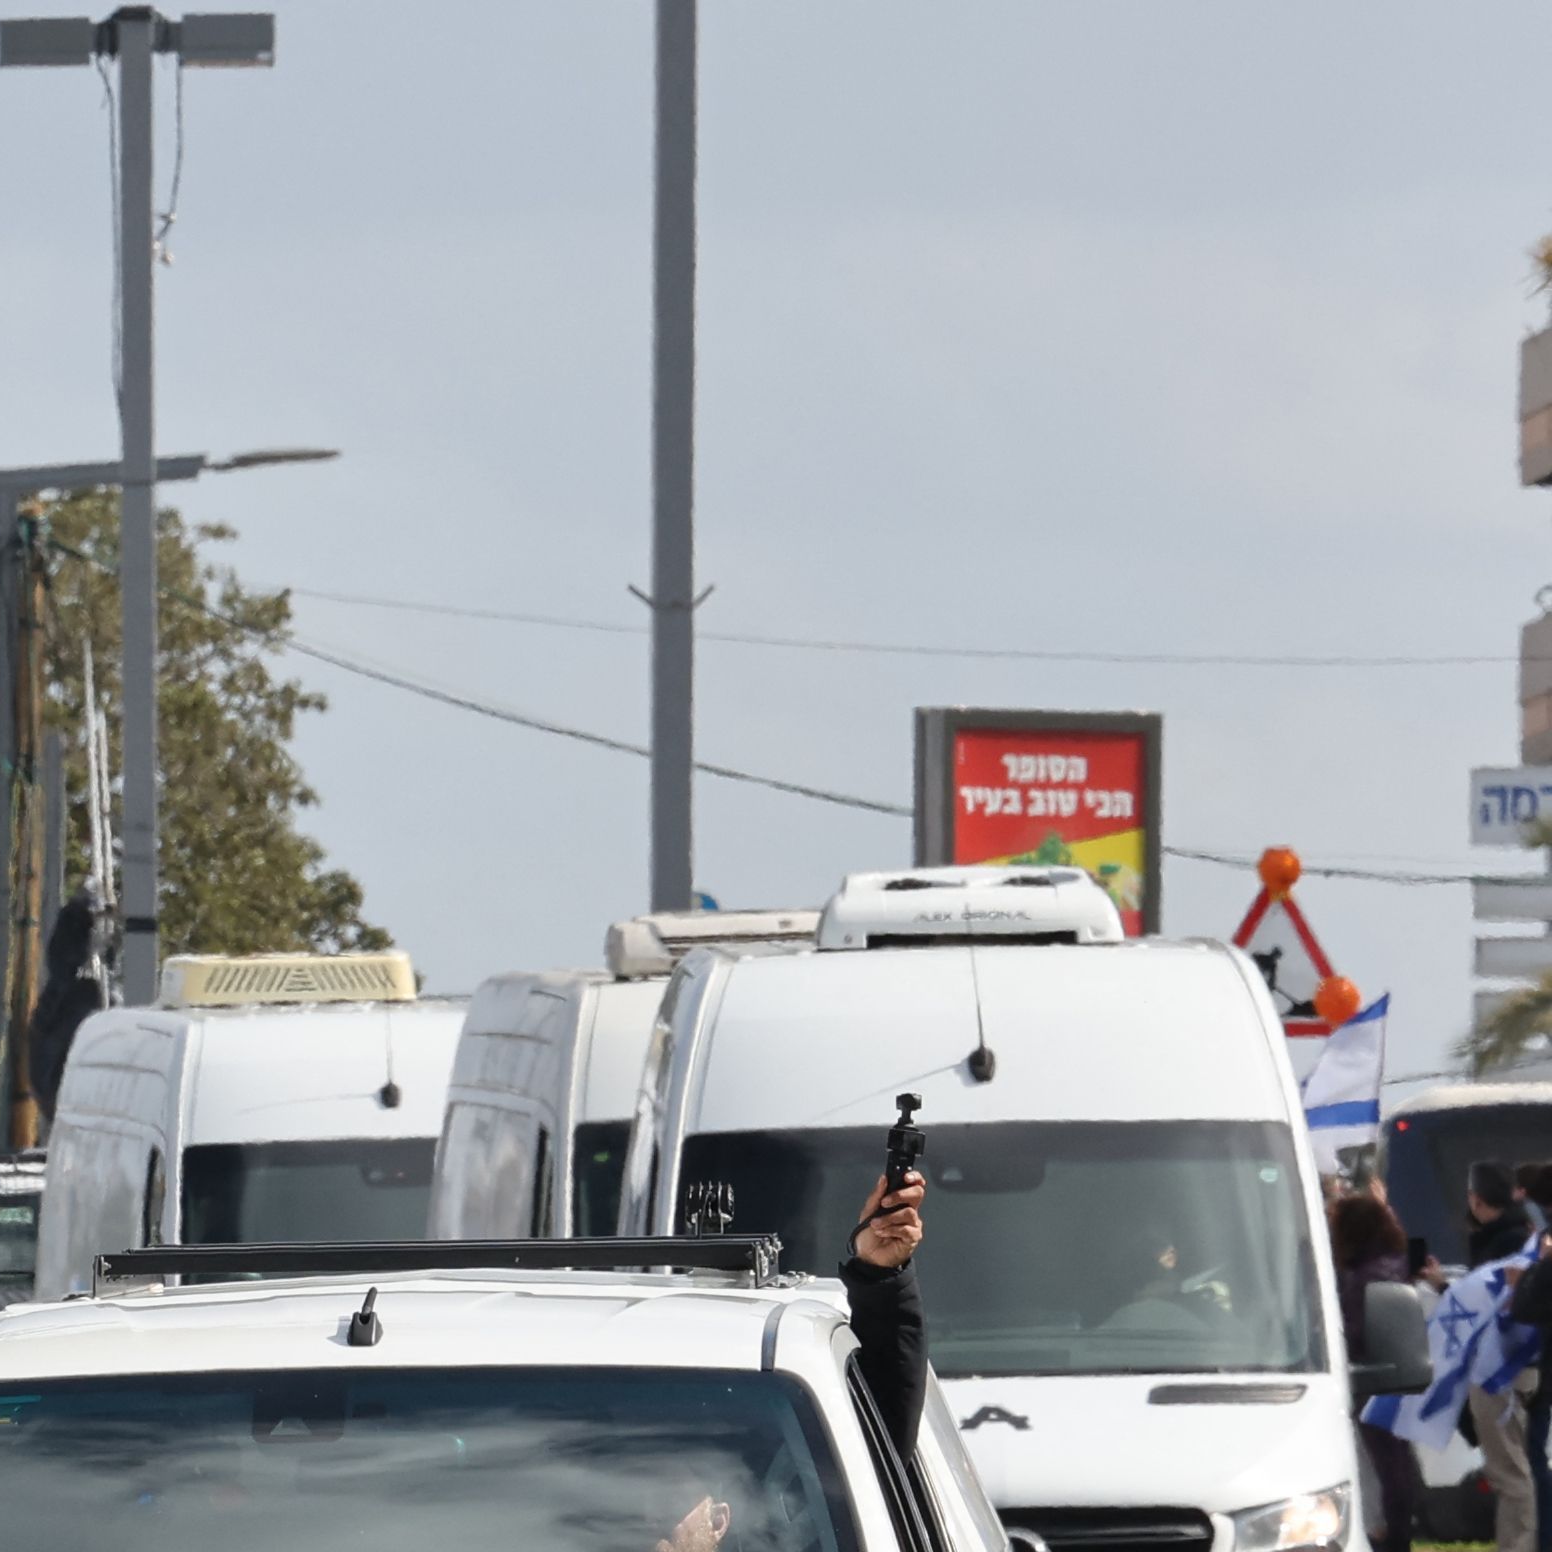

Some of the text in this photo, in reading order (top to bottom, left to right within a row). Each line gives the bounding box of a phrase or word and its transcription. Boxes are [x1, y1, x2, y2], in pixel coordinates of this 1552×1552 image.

[1001, 753, 1087, 783] הסופר
[960, 786, 1023, 816] בעיר
[1027, 788, 1078, 817] טוב
